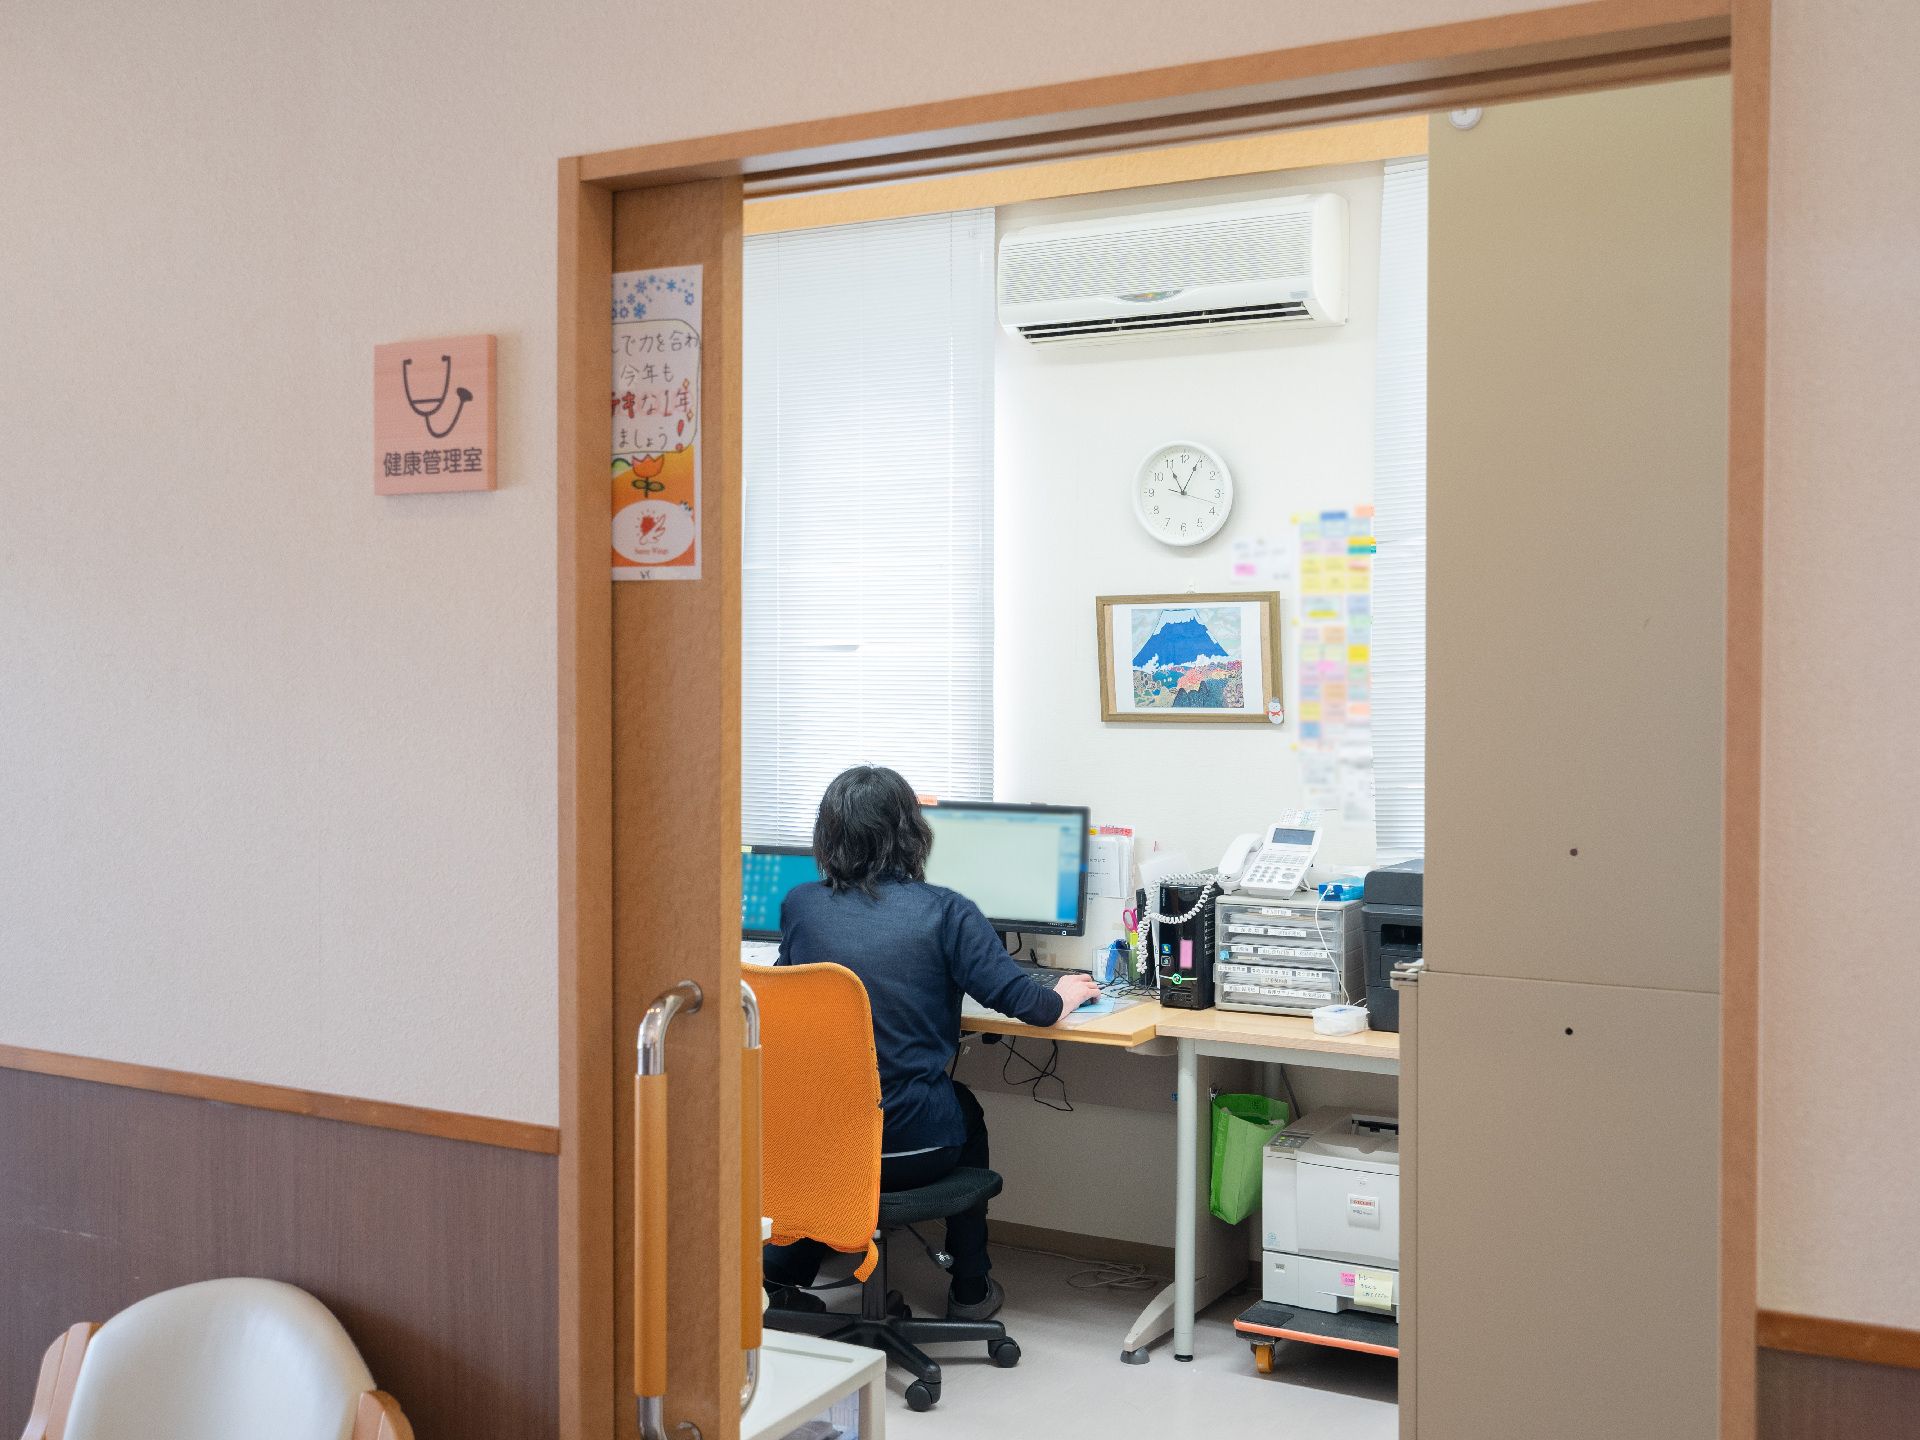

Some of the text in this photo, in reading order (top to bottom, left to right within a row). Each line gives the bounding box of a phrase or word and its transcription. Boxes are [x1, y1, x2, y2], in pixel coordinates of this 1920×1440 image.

[620, 363, 674, 387] 今年も
[383, 447, 483, 477] 健康管理室
[1165, 459, 1174, 469] 11
[1180, 454, 1190, 464] 12
[1154, 472, 1164, 482] 10
[1209, 470, 1216, 481] 2
[1148, 488, 1155, 498] 9
[1214, 488, 1221, 499] 3
[1153, 505, 1160, 515] 8
[1208, 506, 1215, 516] 4
[1165, 517, 1171, 527] 7
[1180, 522, 1187, 532] 6
[1196, 517, 1203, 528] 5
